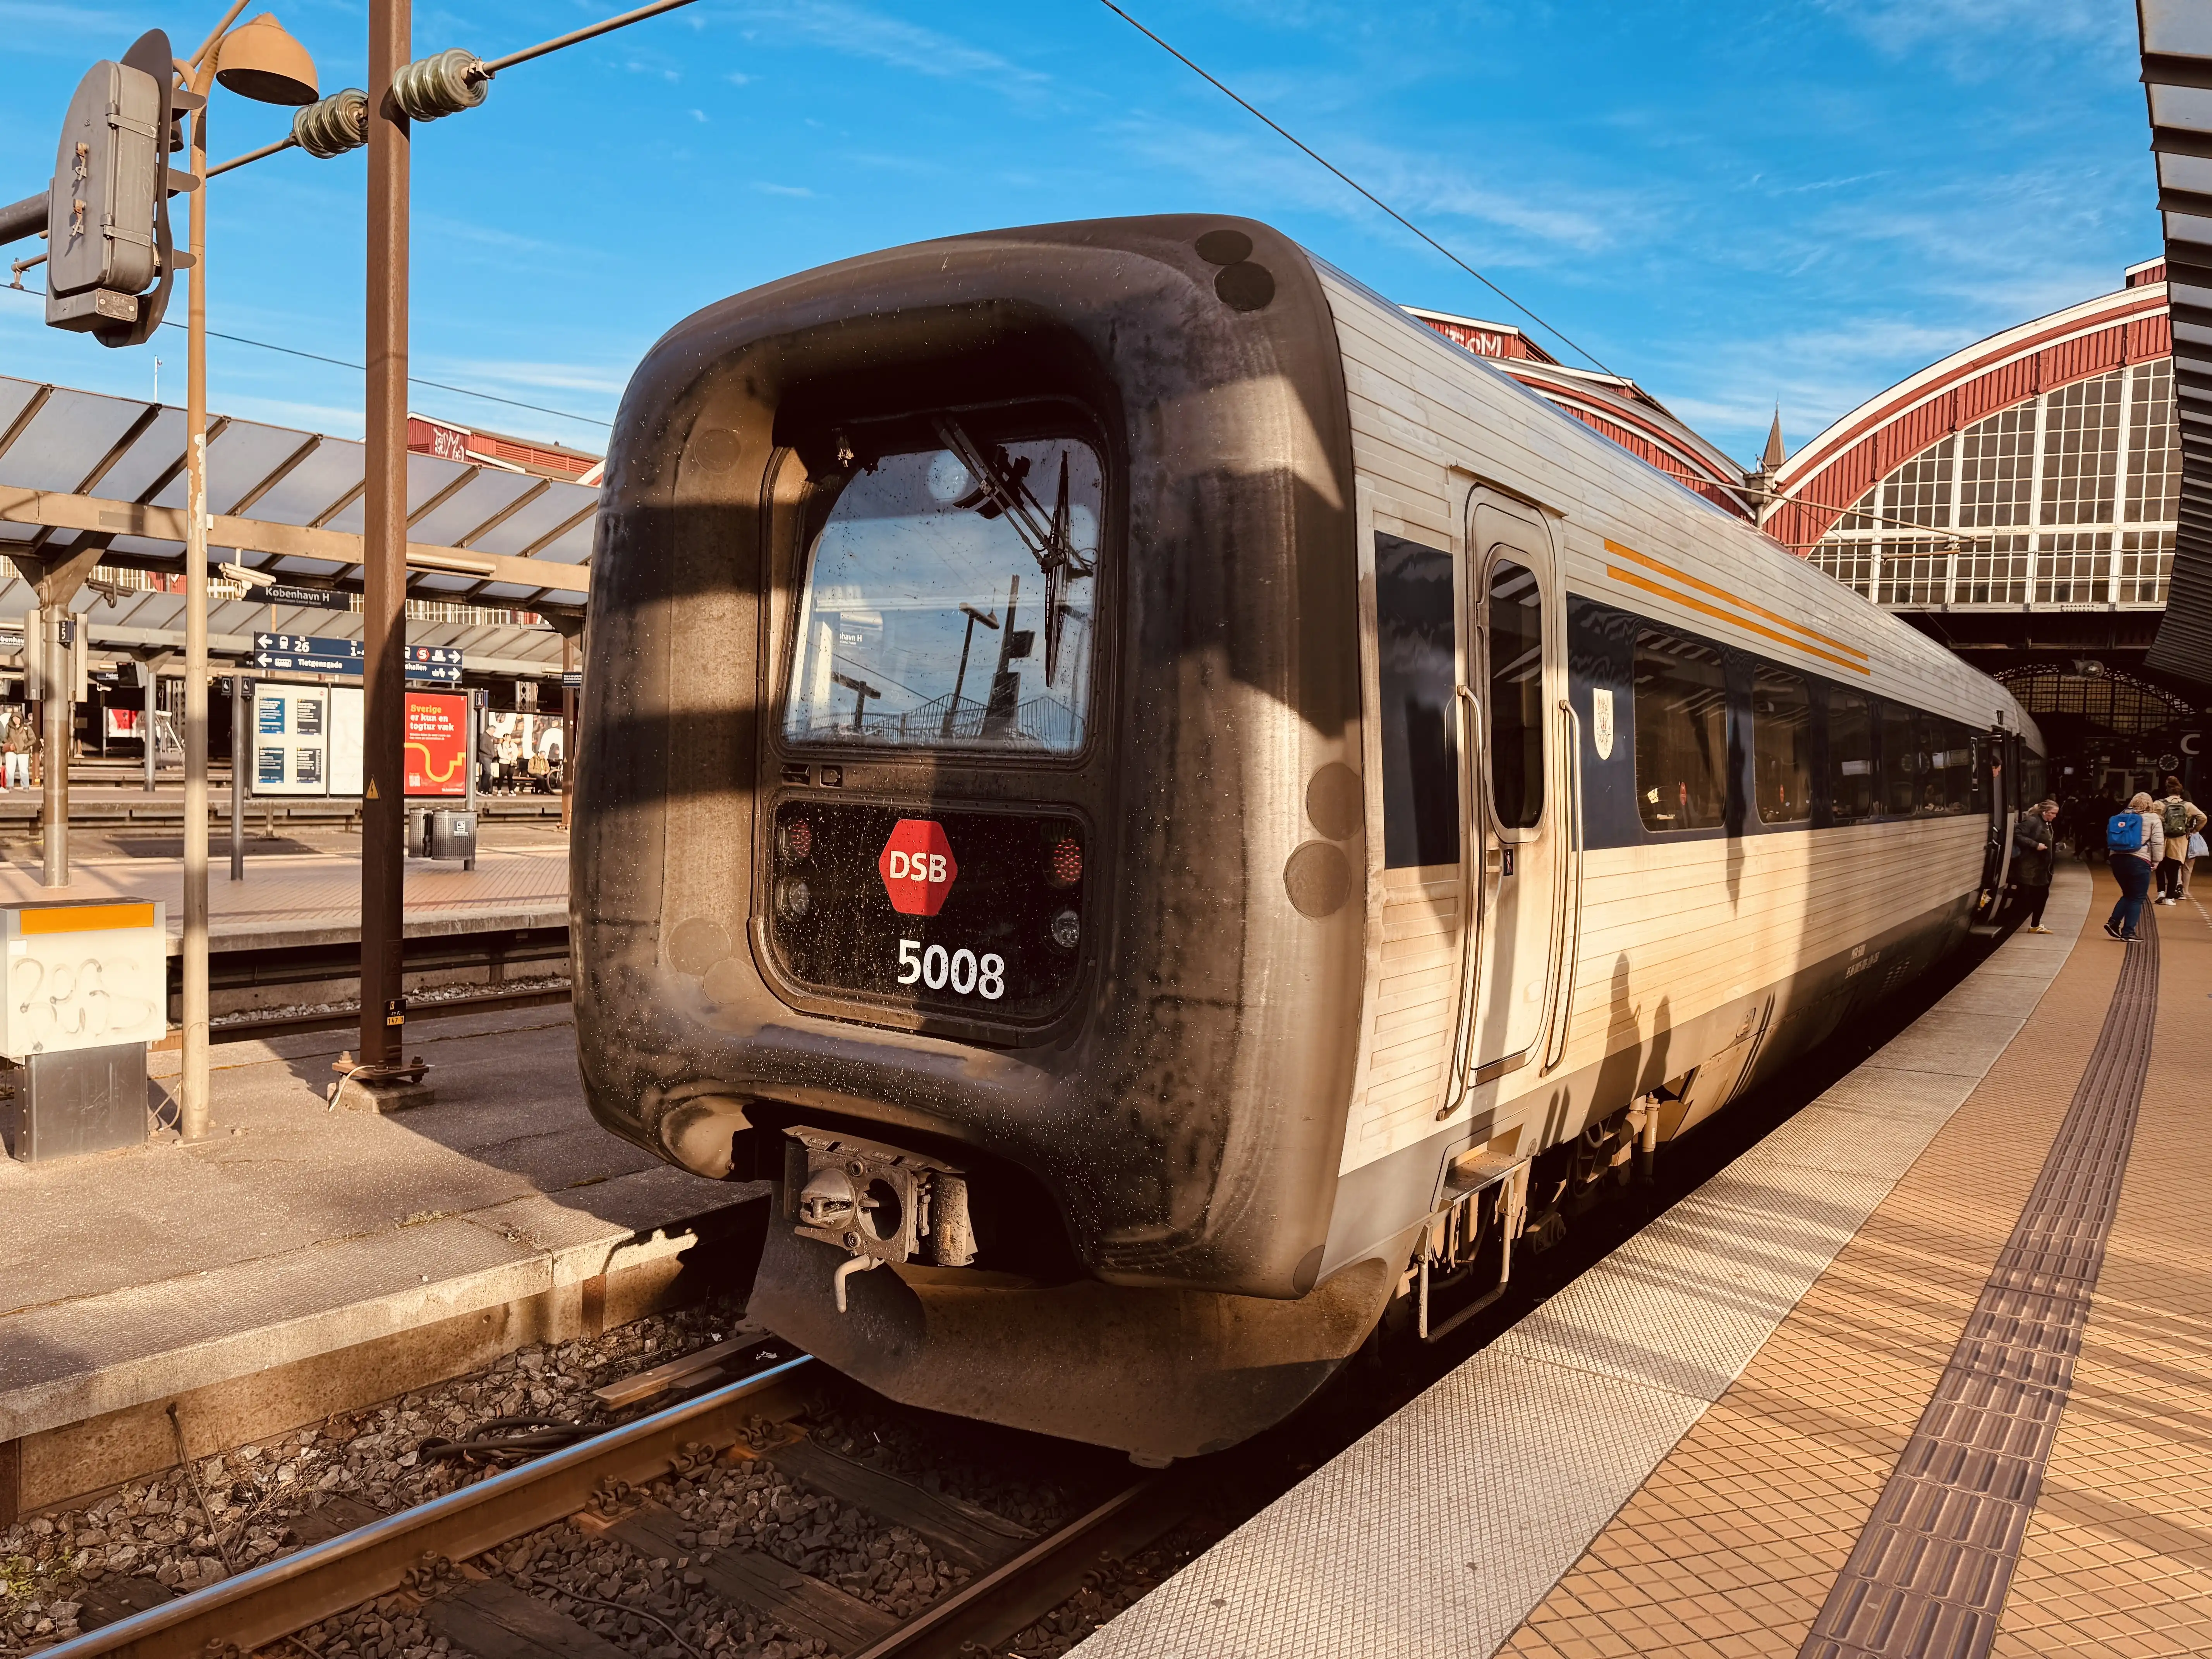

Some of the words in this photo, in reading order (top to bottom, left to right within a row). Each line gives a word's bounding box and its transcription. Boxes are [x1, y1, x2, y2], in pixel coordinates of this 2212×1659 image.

[265, 587, 319, 601] København
[323, 594, 330, 602] H
[61, 628, 66, 639] 5
[294, 641, 310, 653] 26
[298, 658, 343, 669] Tietgensgade
[405, 663, 427, 671] shallen
[410, 704, 441, 714] Sverige
[421, 714, 436, 722] kun
[410, 722, 436, 731] togtur
[2180, 733, 2200, 755] C
[889, 850, 947, 883] DSB
[897, 938, 1004, 1000] 5008
